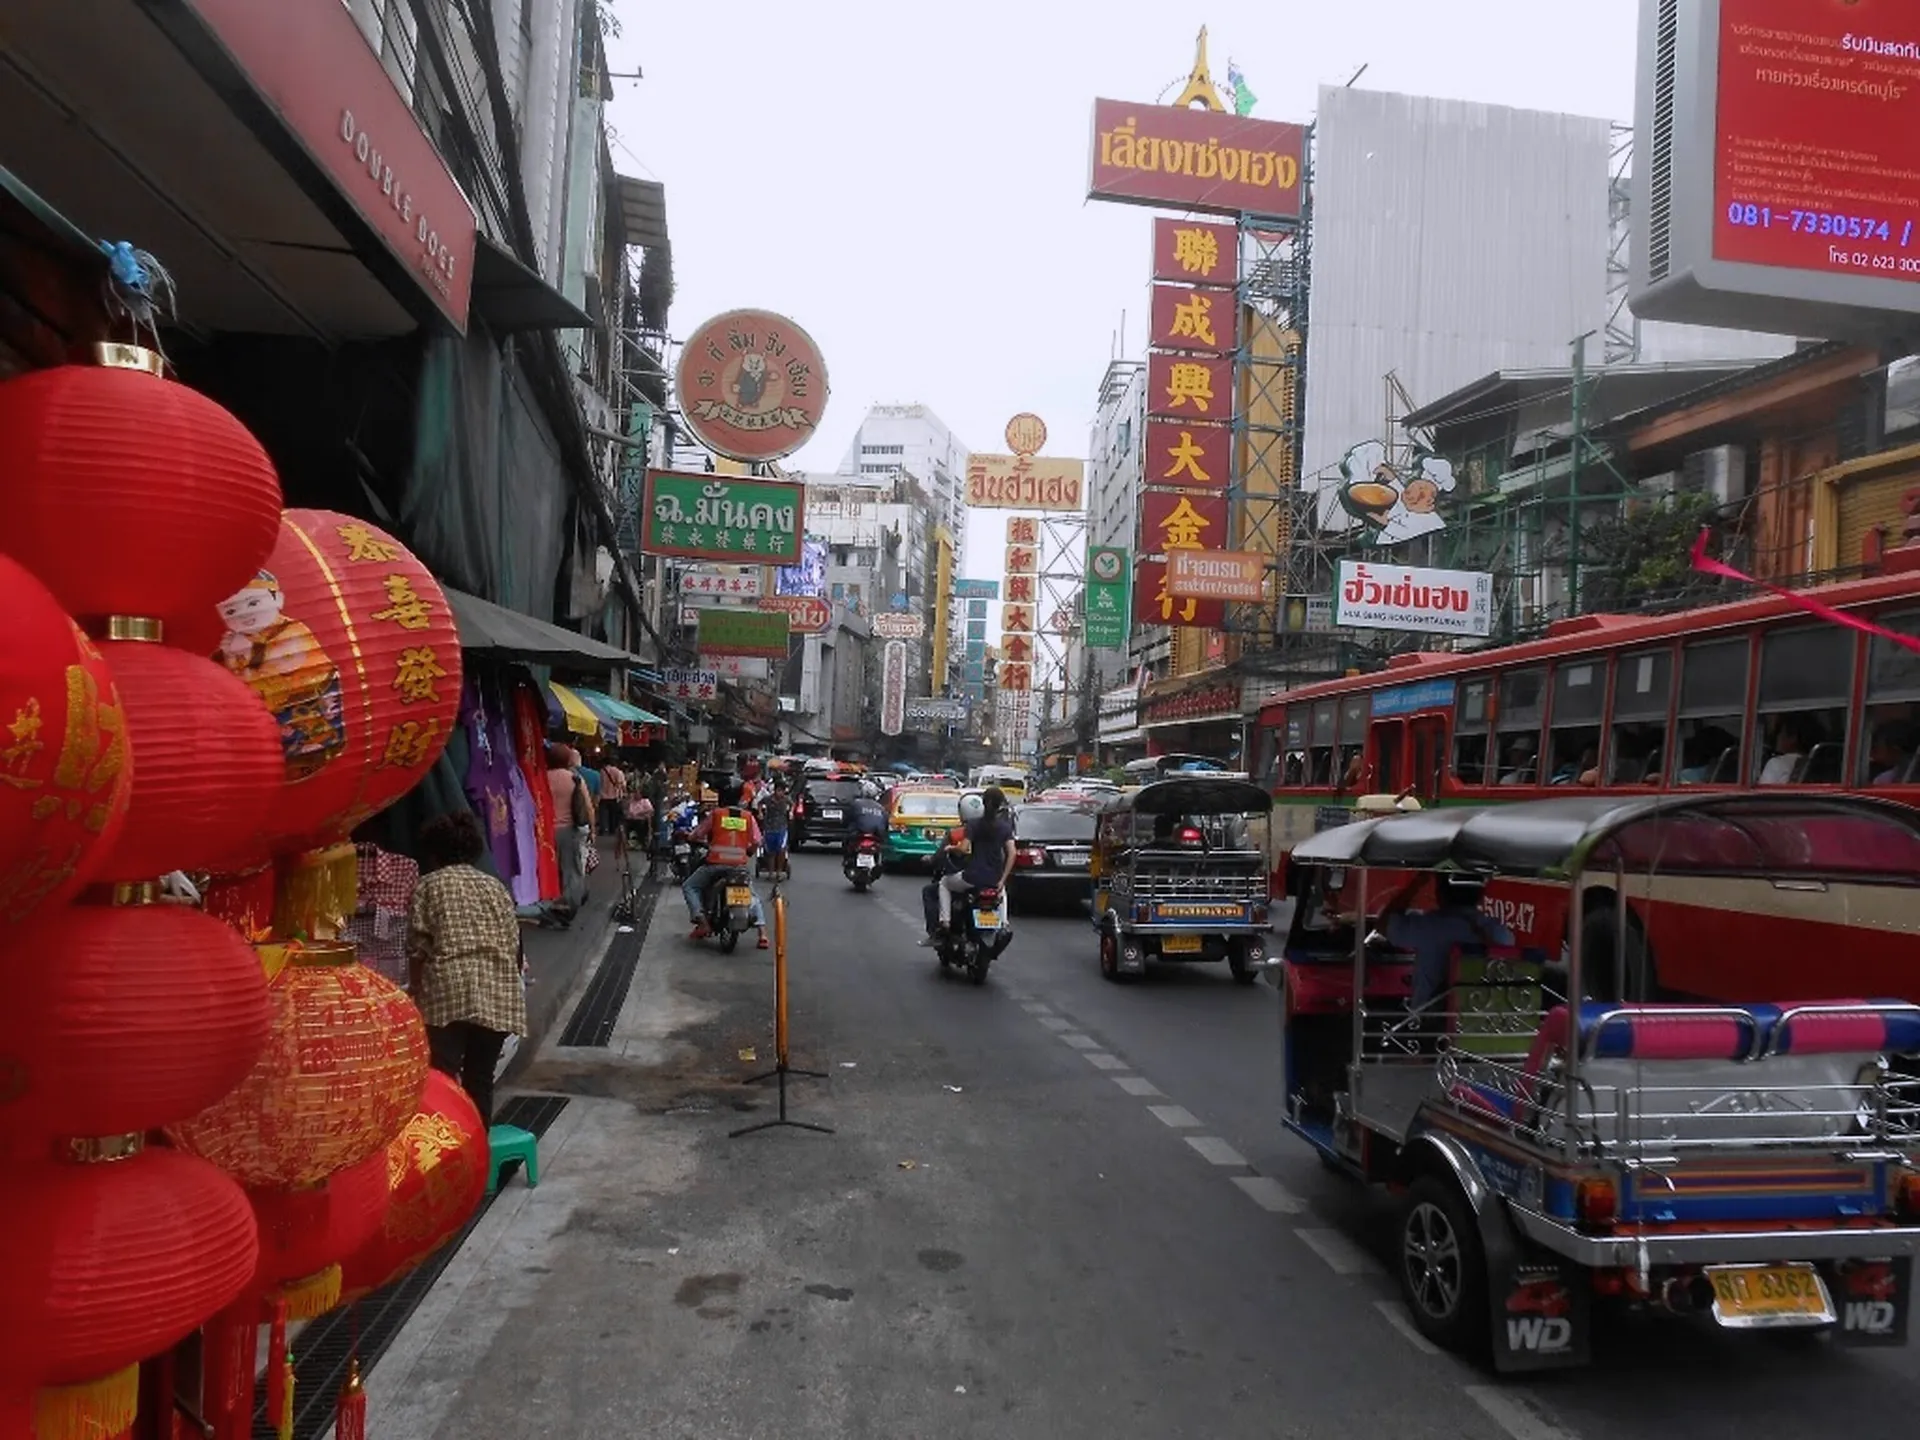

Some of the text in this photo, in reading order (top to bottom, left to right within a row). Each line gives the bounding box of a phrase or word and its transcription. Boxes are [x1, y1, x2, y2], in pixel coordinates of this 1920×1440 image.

[341, 109, 413, 223] DOUBLE
[417, 214, 456, 280] DOGS
[1728, 202, 1890, 242] 081-7330574
[1852, 253, 1869, 267] 02
[1872, 256, 1895, 270] 623
[655, 481, 794, 533] ฉ.มั่นคง
[1176, 552, 1241, 579] ที่จอดรถ
[1344, 564, 1469, 612] ฮั้วเซ่งฮง
[1758, 1271, 1819, 1299] 3362
